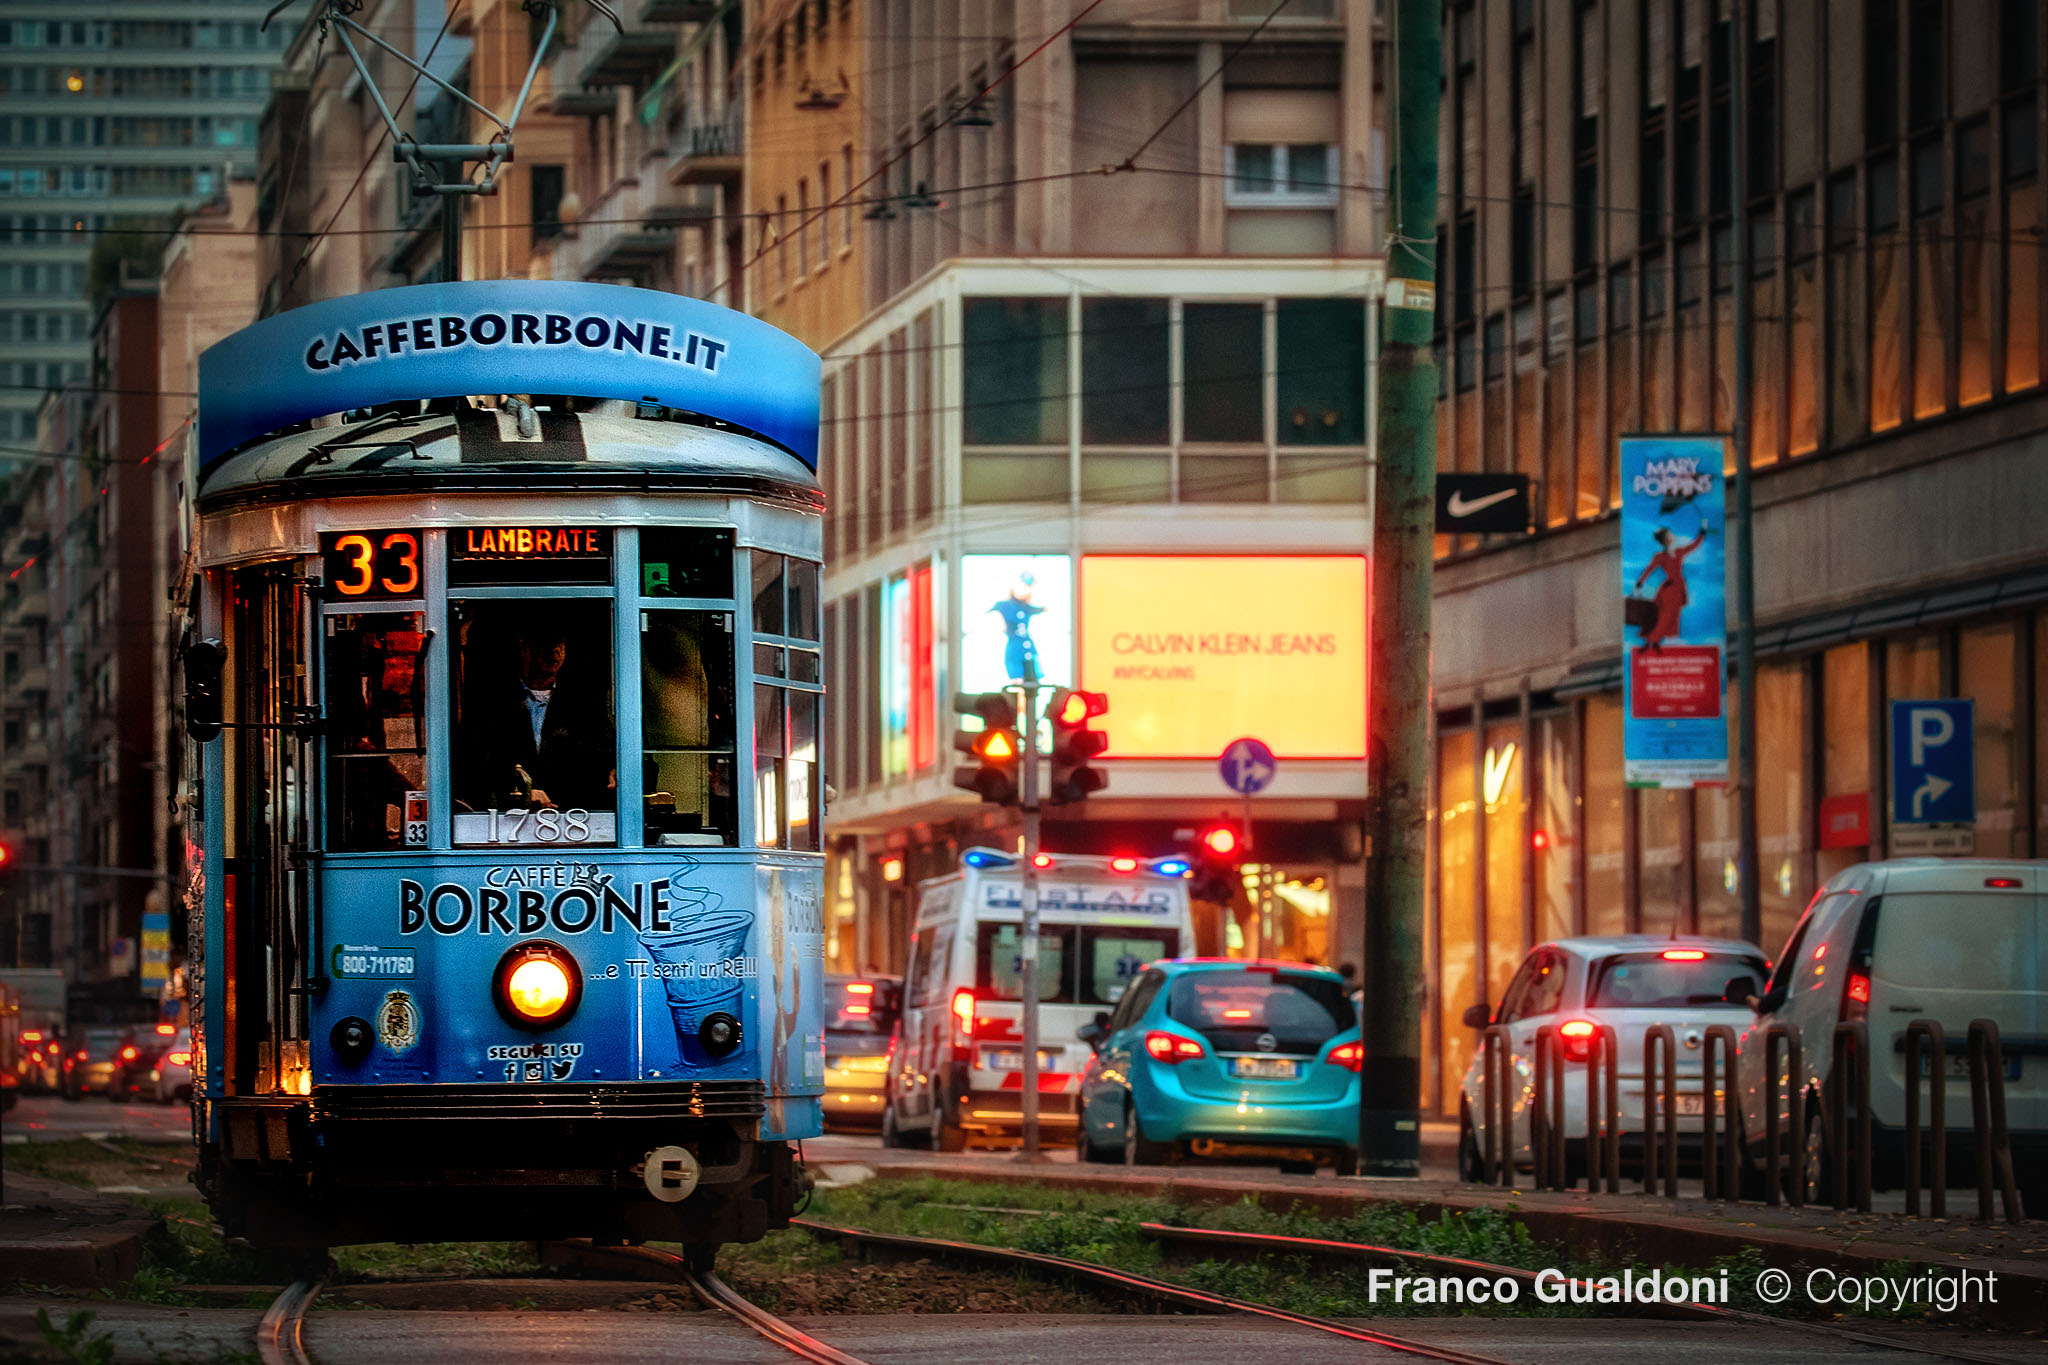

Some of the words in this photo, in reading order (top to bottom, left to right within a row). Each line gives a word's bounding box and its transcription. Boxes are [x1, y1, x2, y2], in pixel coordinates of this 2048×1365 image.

[305, 313, 726, 372] CAFFEBORBONE.IT
[1646, 457, 1700, 476] MARY
[466, 528, 599, 553] LAMBRATE
[334, 533, 419, 595] 33
[1111, 632, 1194, 656] CALVIN
[1200, 632, 1261, 656] KLEIN
[1265, 632, 1337, 656] JEANS
[1910, 708, 1955, 766] P
[408, 823, 428, 843] 33
[486, 807, 591, 842] 1788
[486, 860, 567, 888] CAFFÈ
[400, 876, 672, 936] BORBONE
[342, 955, 415, 974] 800-711760
[652, 958, 695, 978] senti
[699, 962, 717, 978] un
[560, 1044, 581, 1057] SU
